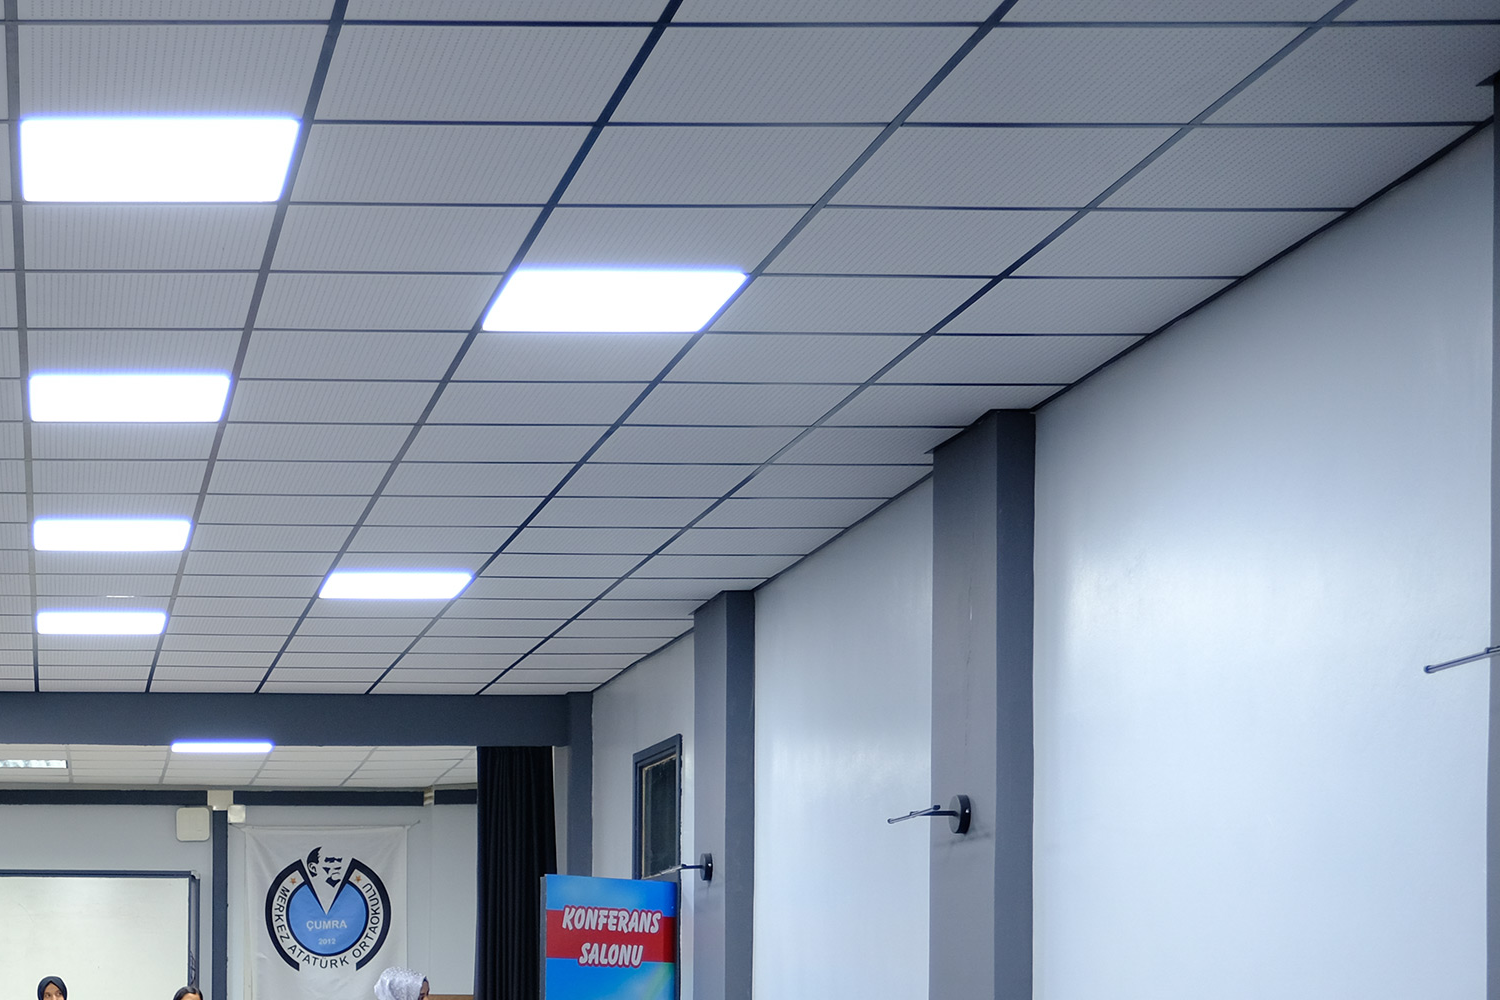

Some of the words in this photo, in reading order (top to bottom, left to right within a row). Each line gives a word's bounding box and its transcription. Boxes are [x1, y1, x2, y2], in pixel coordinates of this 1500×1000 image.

[274, 886, 290, 943] MERKEZ
[287, 944, 350, 969] ATATÜRK
[351, 883, 381, 958] ORTAOKULU
[306, 920, 348, 932] ÇUMRA
[562, 906, 662, 934] KONFERANS
[578, 942, 644, 967] SALONU
